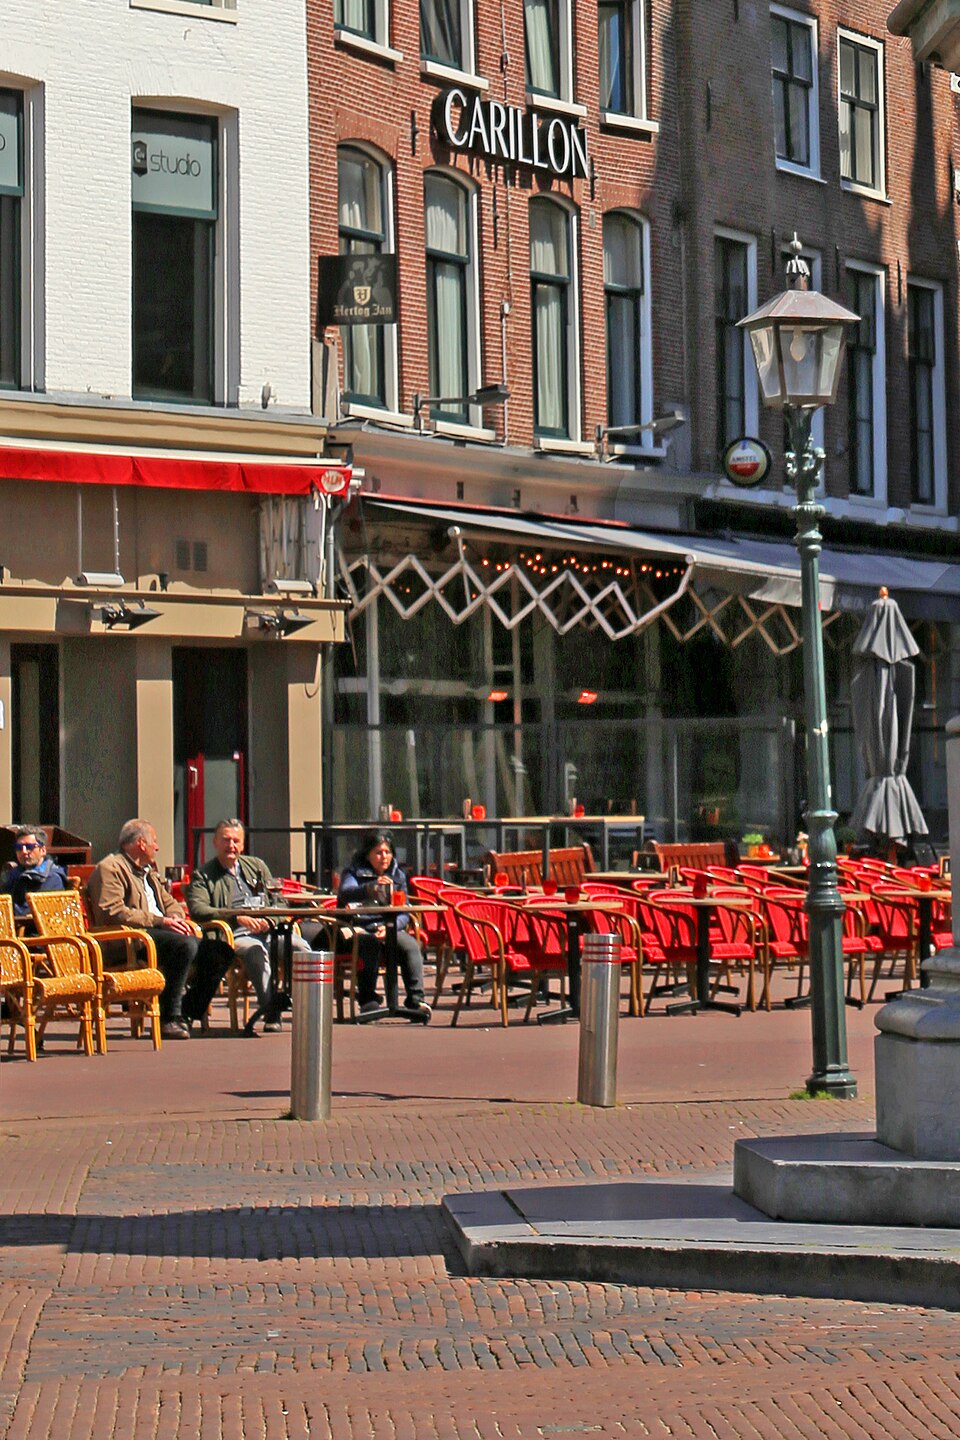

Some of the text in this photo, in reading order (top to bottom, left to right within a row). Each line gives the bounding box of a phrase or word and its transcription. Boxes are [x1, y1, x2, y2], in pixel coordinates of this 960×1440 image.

[445, 89, 589, 178] CARILLON
[150, 149, 201, 177] studio
[334, 304, 392, 317] Hertog Jan
